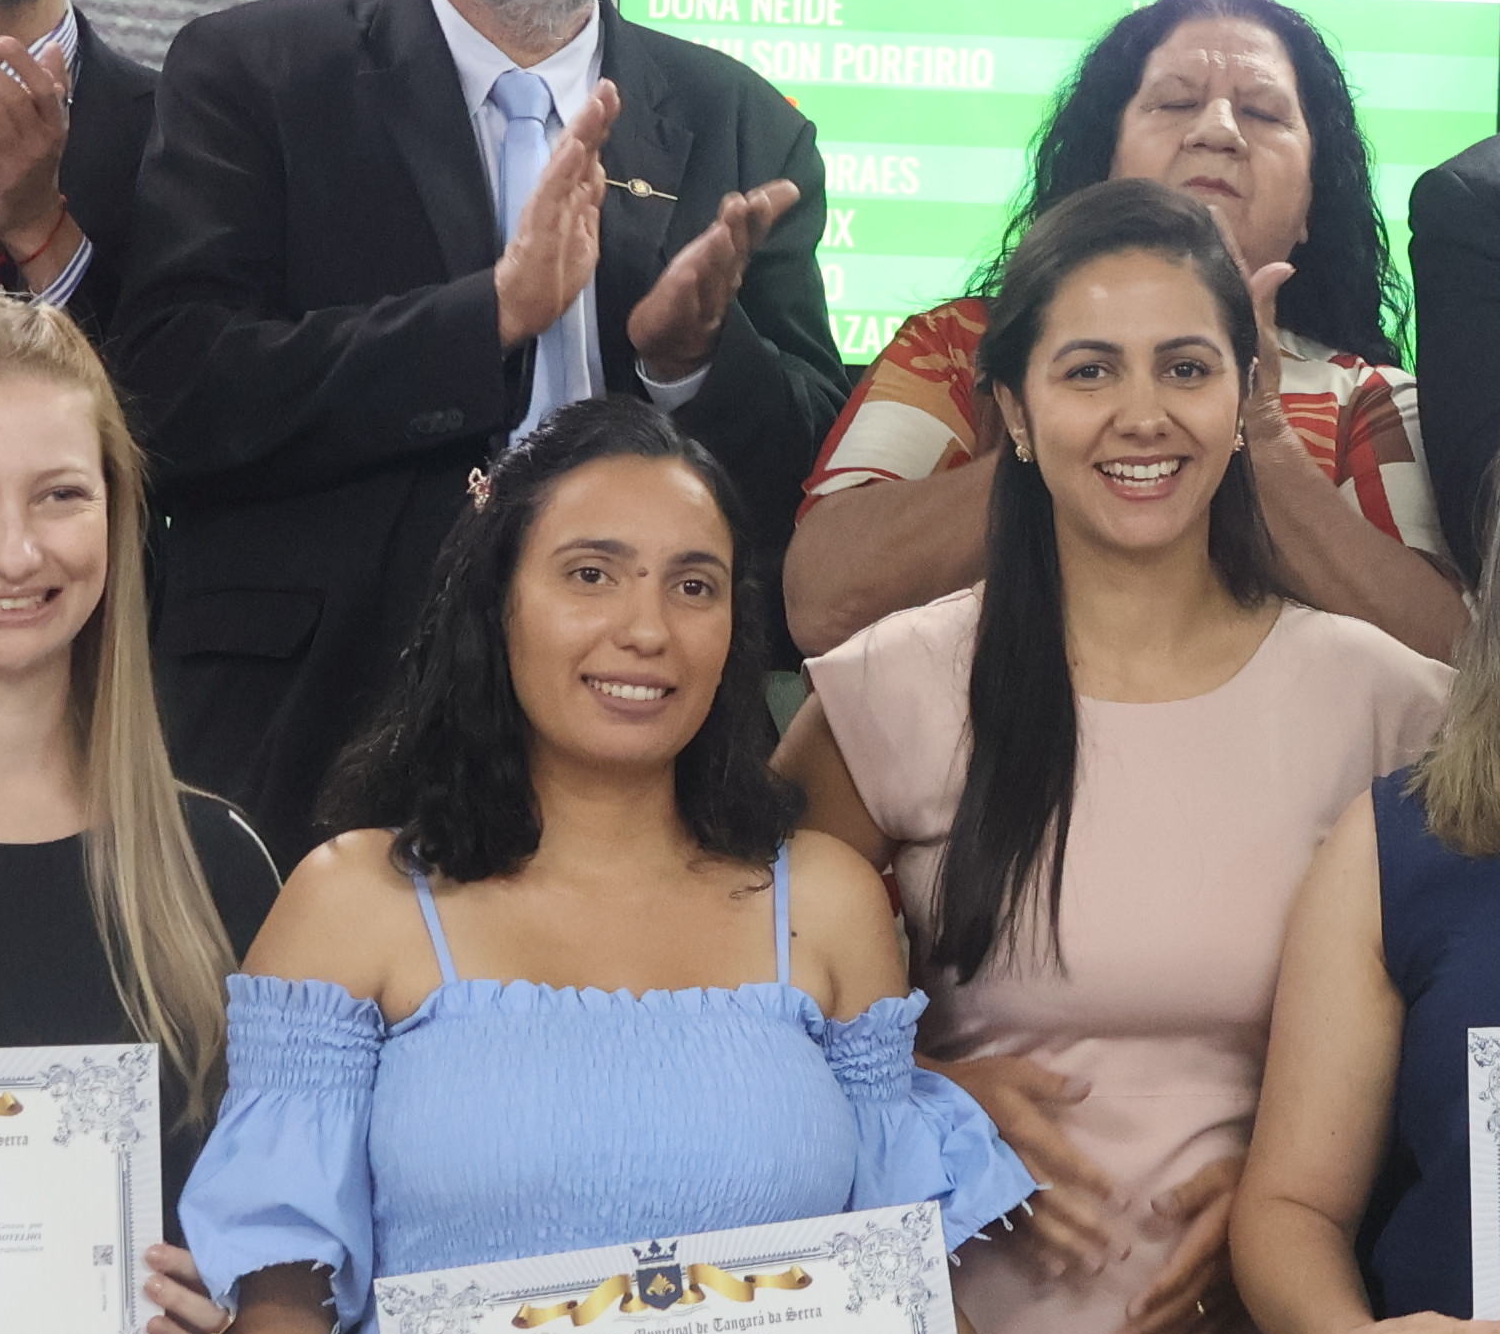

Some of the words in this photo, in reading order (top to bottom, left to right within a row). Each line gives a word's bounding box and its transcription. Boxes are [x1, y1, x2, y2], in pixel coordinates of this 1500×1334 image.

[832, 41, 994, 88] PORFIRIO
[695, 1321, 709, 1334] de
[712, 1309, 765, 1333] Tangará
[767, 1311, 782, 1325] da
[784, 1306, 823, 1322] Serra
